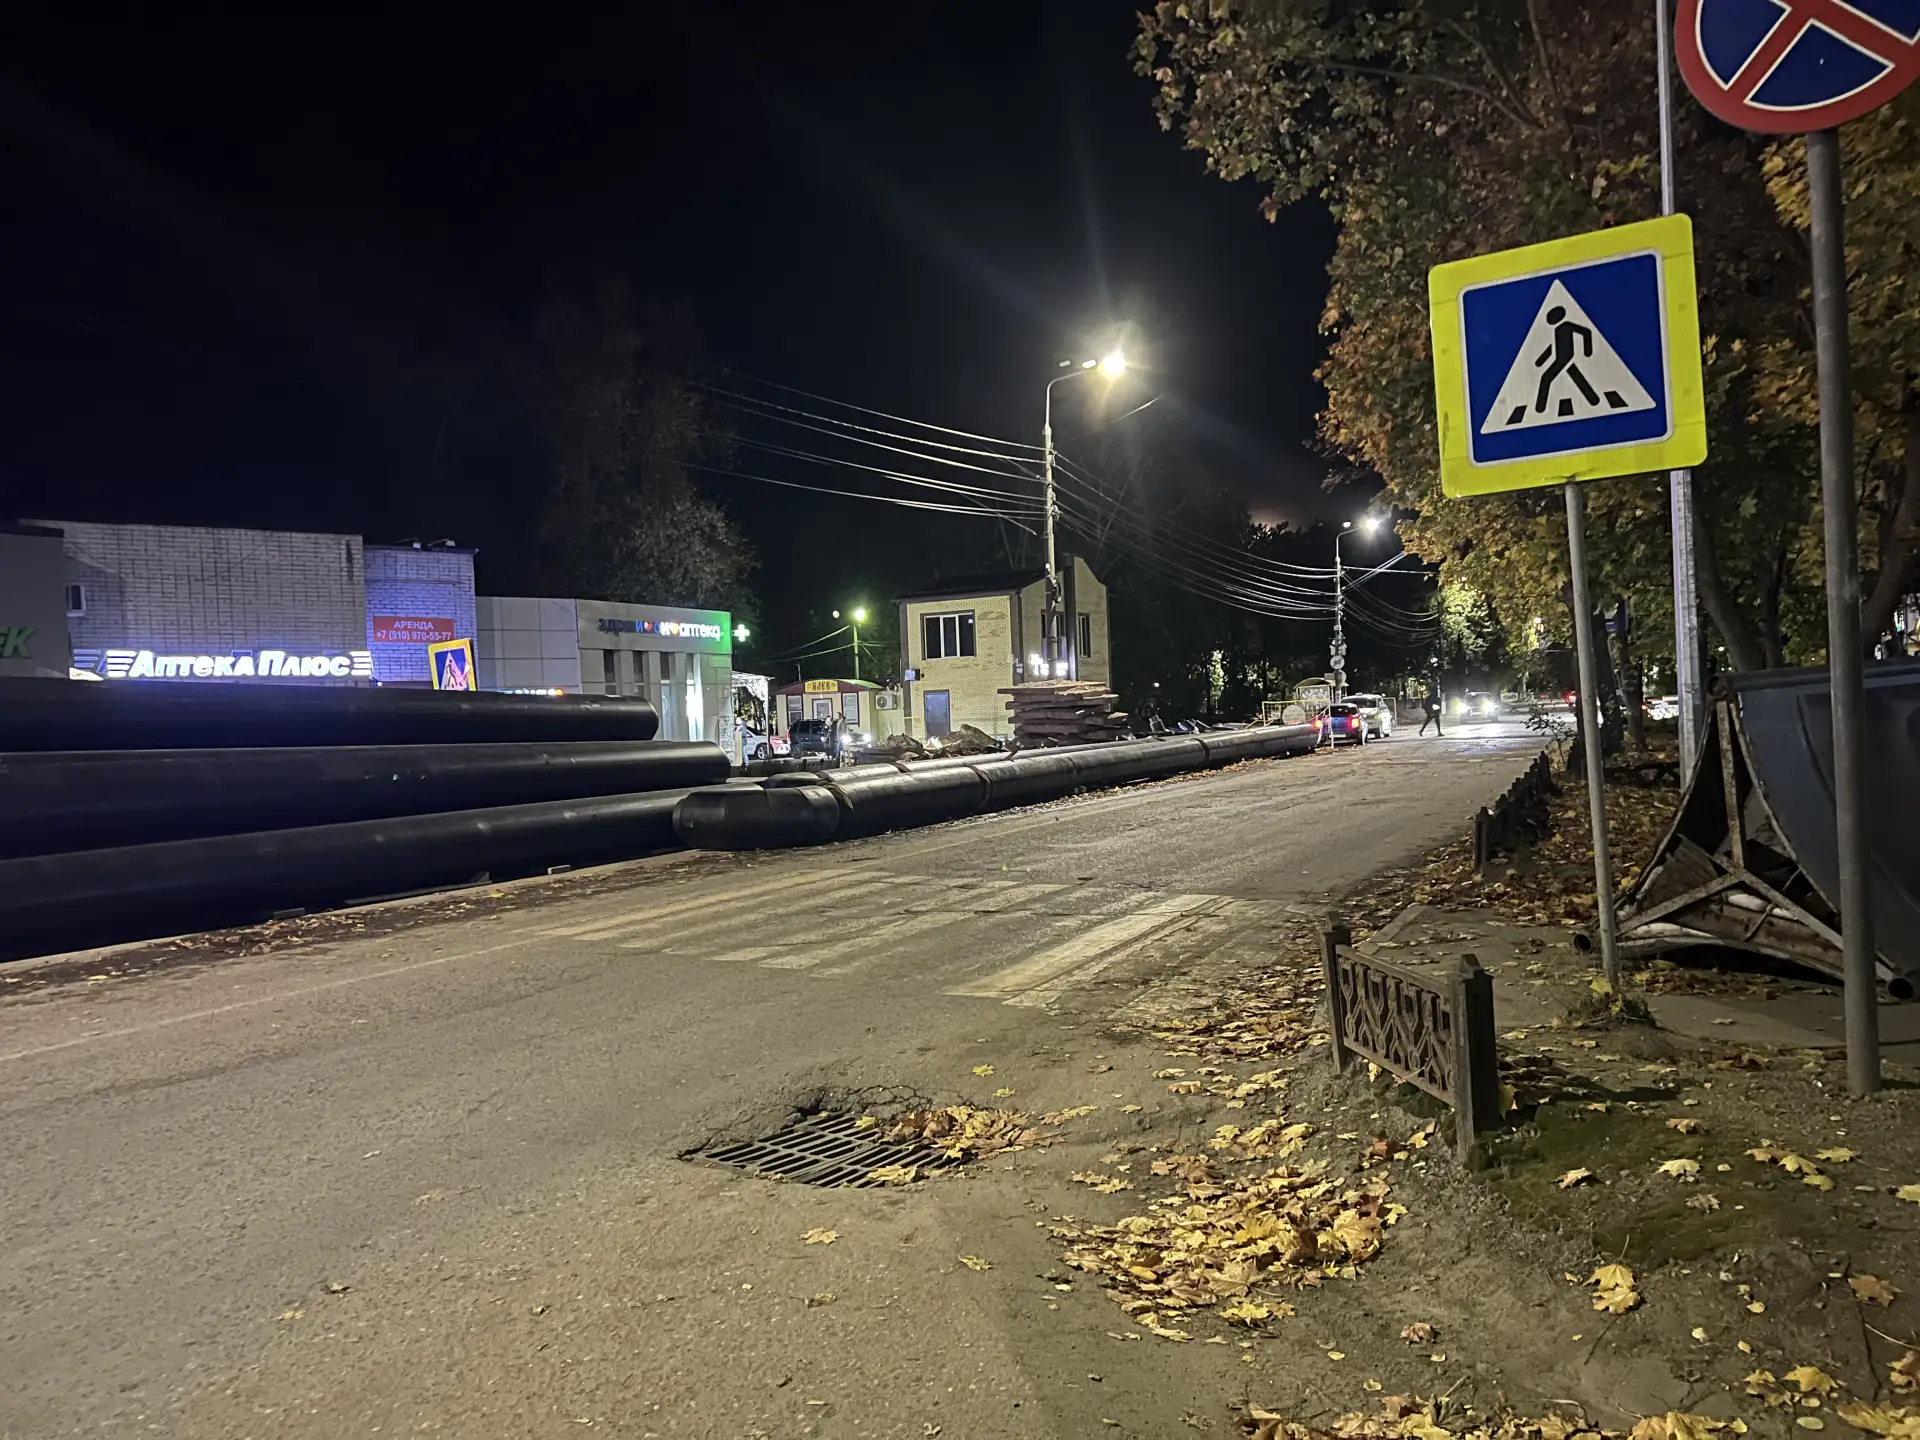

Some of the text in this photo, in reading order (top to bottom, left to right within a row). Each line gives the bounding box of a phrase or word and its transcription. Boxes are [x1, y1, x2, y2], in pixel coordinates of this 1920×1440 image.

[394, 621, 434, 630] АРЕНДА
[376, 630, 452, 641] +7 (910) 970-55-77
